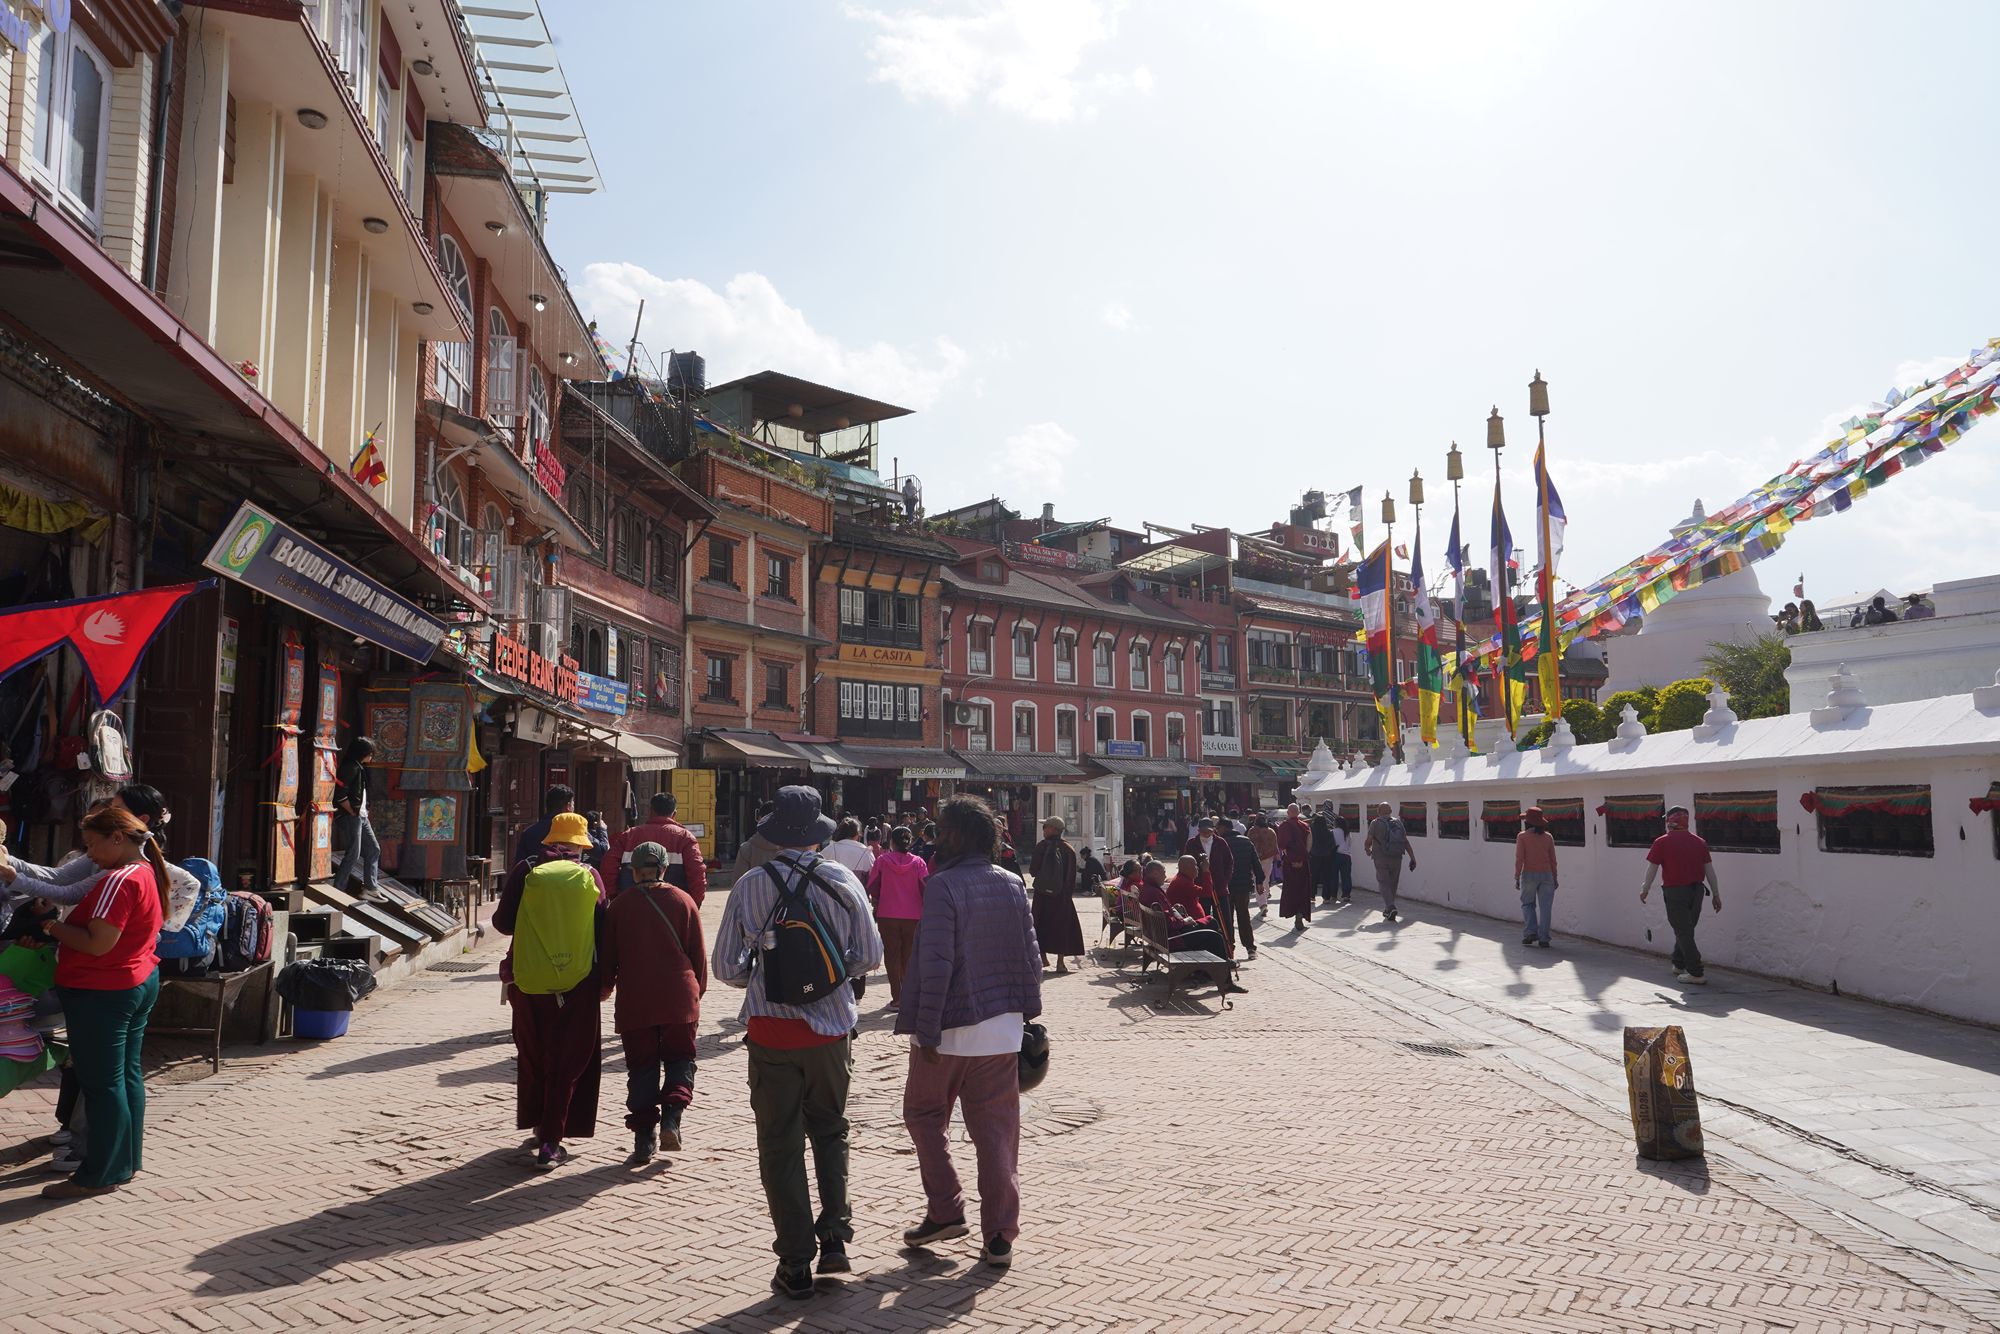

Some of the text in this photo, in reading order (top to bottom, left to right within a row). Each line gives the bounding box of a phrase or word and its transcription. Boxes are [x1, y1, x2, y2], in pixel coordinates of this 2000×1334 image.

[271, 536, 339, 589] BOUDHA
[333, 574, 376, 610] STUPA
[373, 594, 417, 630] THANKA
[853, 647, 867, 658] LA
[873, 649, 912, 661] CASITA
[530, 650, 555, 696] BEANS
[557, 665, 579, 705] COFFEE
[905, 767, 956, 775] PERSIAN ART
